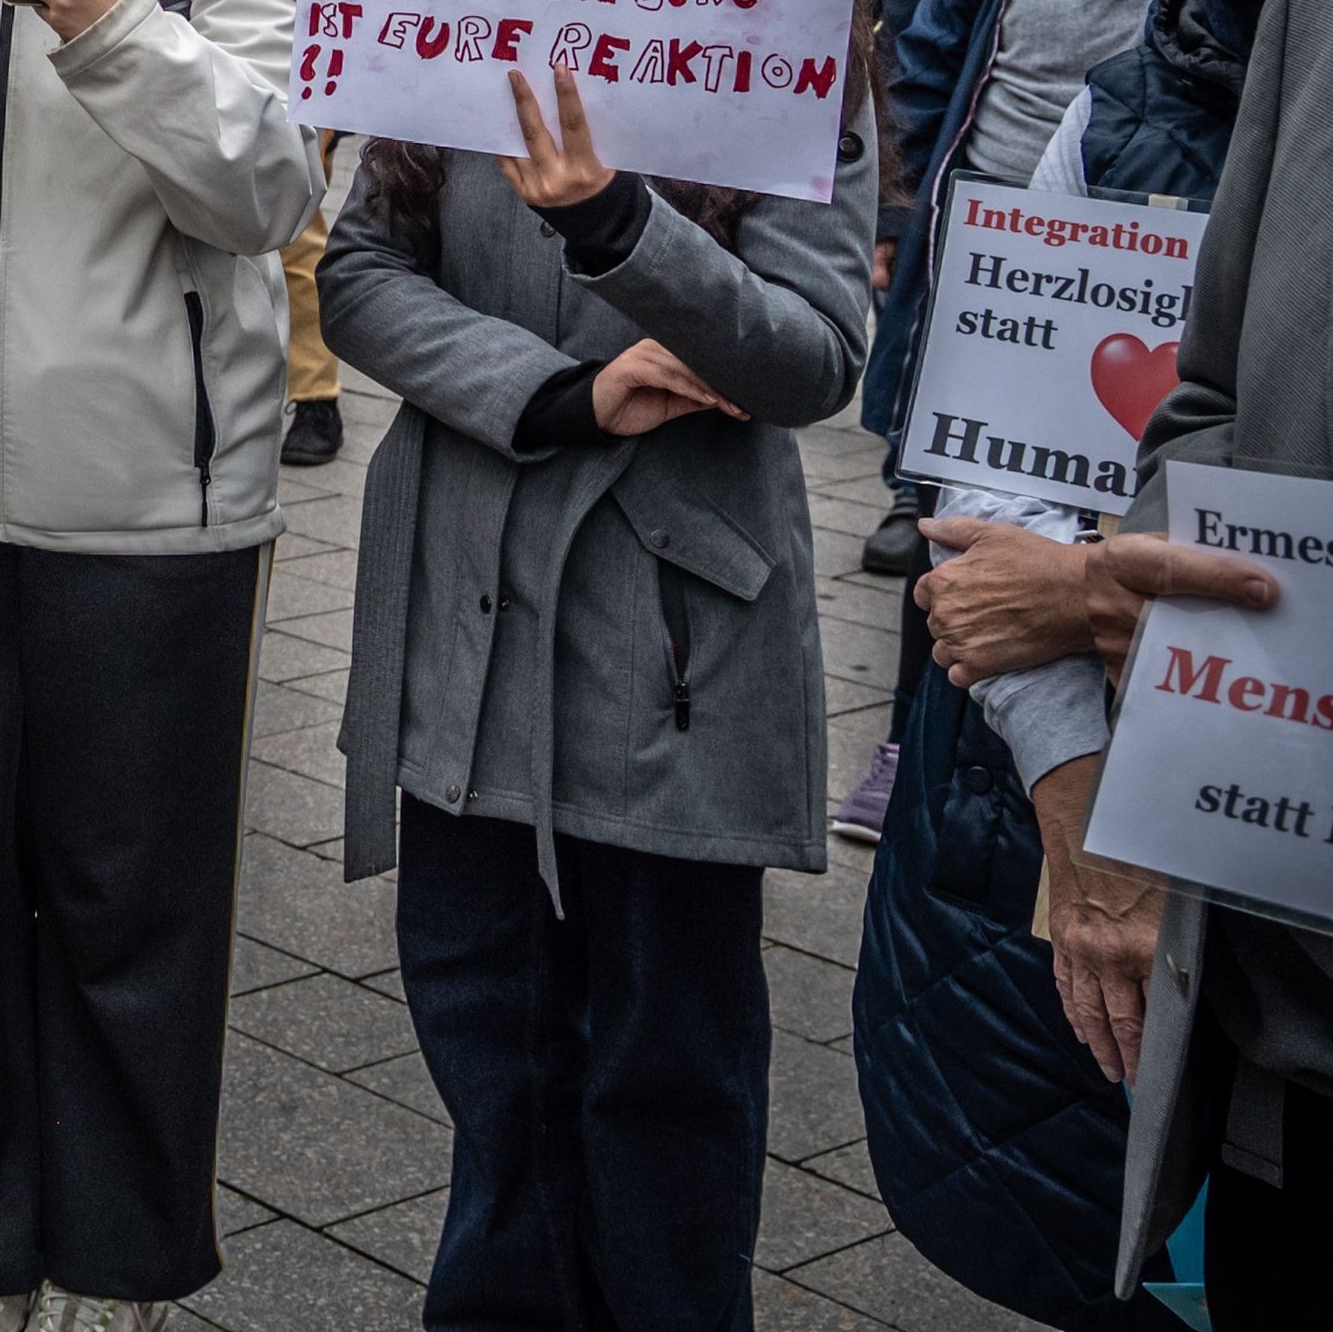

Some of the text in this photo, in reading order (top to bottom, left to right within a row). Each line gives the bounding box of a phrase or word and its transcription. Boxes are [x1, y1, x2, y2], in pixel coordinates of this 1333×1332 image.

[308, 2, 837, 99] IST EURE REAKTION
[963, 199, 1190, 260] Integration
[955, 308, 1058, 350] statt
[923, 411, 1138, 498] Huma
[1195, 783, 1315, 838] statt
